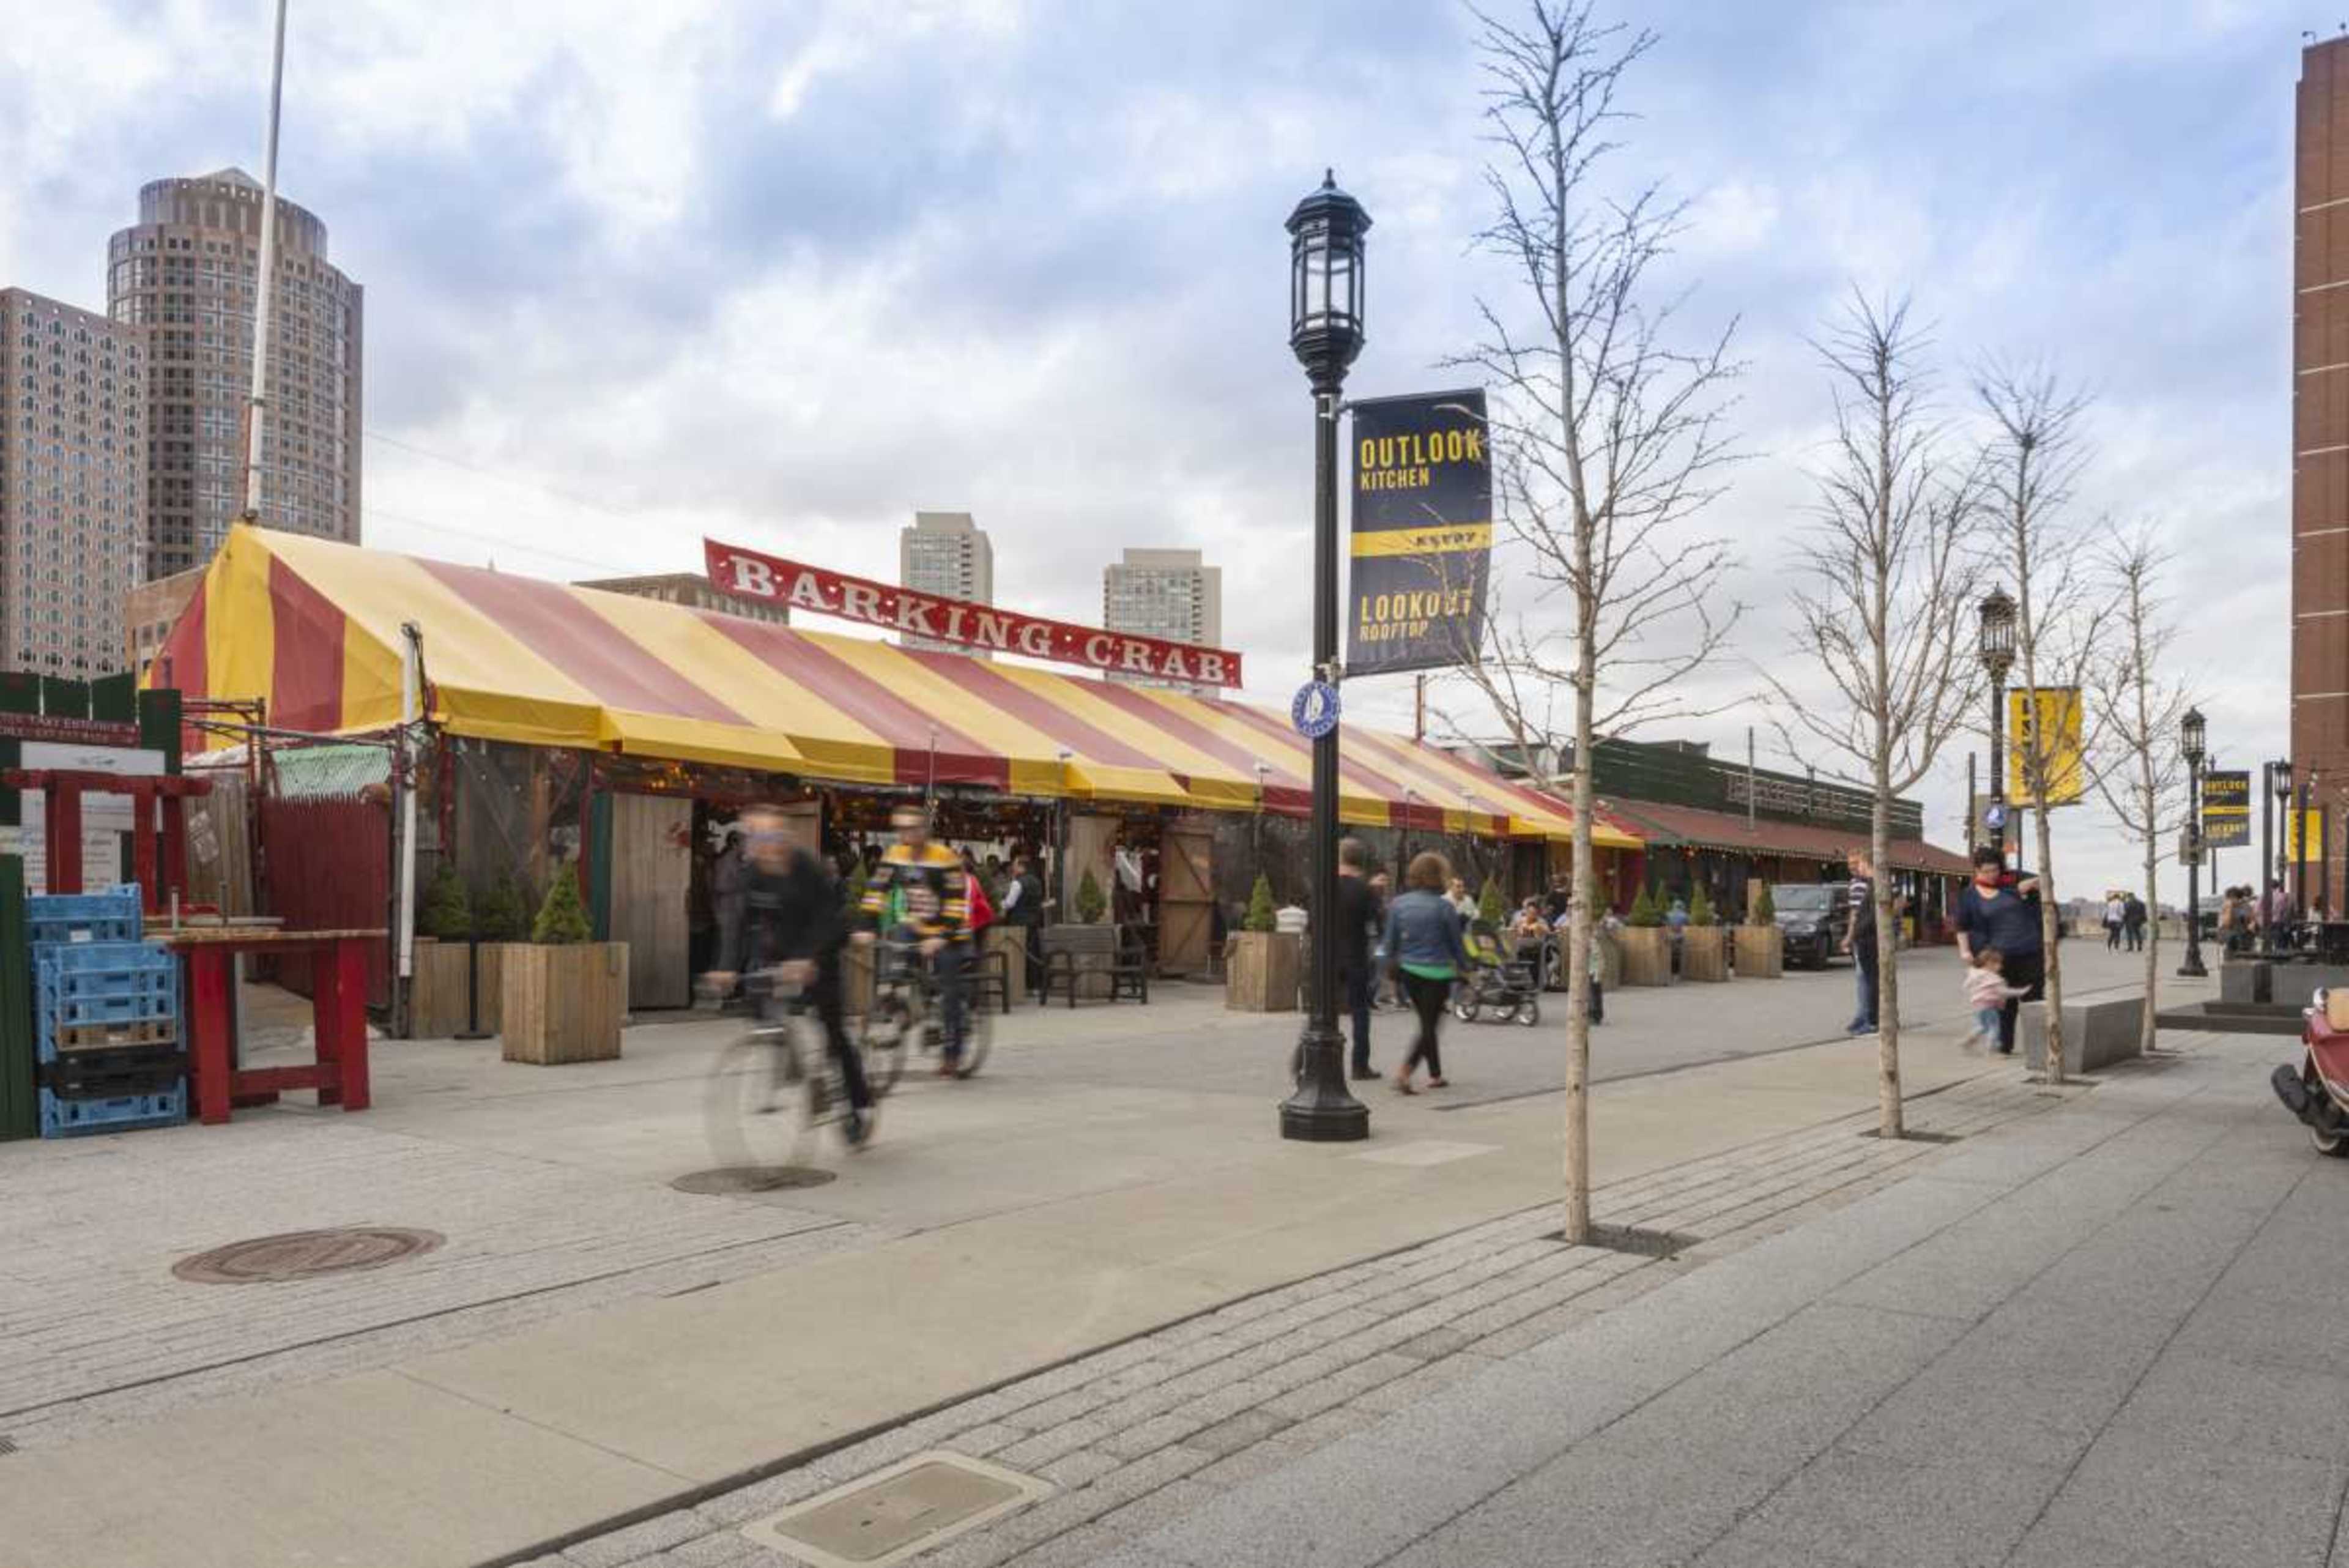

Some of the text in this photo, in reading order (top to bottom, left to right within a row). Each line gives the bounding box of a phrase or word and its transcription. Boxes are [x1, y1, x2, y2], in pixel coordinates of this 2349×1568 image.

[1361, 429, 1482, 469] OUTLOOK
[1361, 467, 1430, 490] KITCHEN
[1361, 589, 1472, 622] LOOKOUT
[1360, 620, 1429, 642] ROOFTOP
[1085, 635, 1225, 682] CRAB
